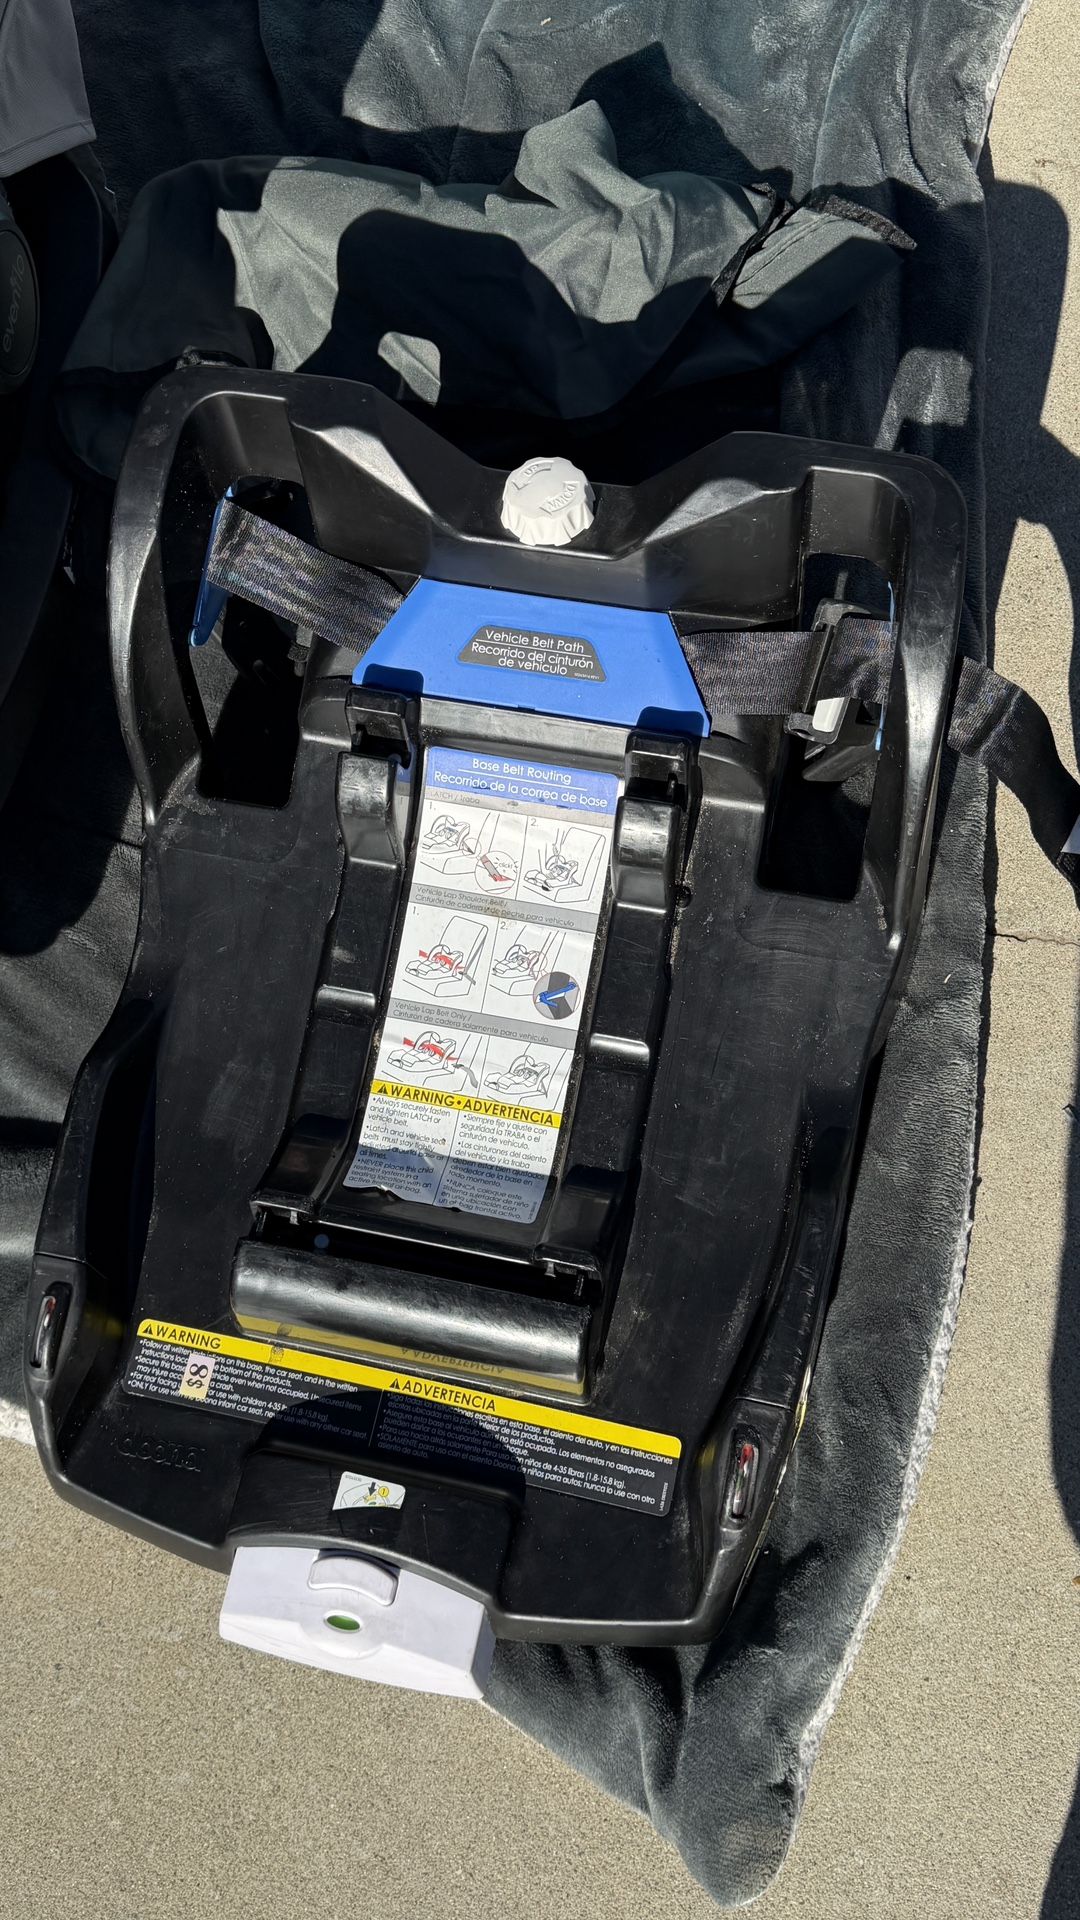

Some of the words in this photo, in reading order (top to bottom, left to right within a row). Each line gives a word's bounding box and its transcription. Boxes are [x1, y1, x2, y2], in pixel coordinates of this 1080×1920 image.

[486, 630, 529, 645] Vehicle
[533, 636, 554, 648] Belt
[557, 640, 584, 653] Path
[472, 642, 525, 658] Recorrido
[528, 650, 545, 662] del
[549, 654, 593, 669] cinturón
[498, 657, 514, 667] de
[471, 758, 500, 772] Base
[503, 763, 523, 776] Belt
[526, 767, 572, 785] Routing
[433, 770, 490, 790] Recorrido
[489, 780, 505, 792] de
[507, 782, 519, 794] la
[520, 786, 558, 800] correa
[560, 791, 576, 803] de
[579, 793, 608, 808] base
[416, 885, 442, 896] Vehicle
[443, 890, 457, 900] Lap
[445, 898, 455, 906] de
[526, 914, 543, 923] para
[394, 1001, 420, 1012] Vehicle
[421, 1006, 435, 1015] Lap
[436, 1008, 449, 1017] Belt
[450, 1011, 466, 1021] Only
[423, 1014, 433, 1022] de
[434, 1016, 461, 1027] cadera
[461, 1021, 499, 1034] solamente
[499, 1029, 517, 1038] para
[375, 1096, 400, 1108] Always
[400, 1101, 428, 1113] securely
[429, 1107, 450, 1116] fasten
[390, 1085, 455, 1106] WARNING
[367, 1113, 392, 1123] vehicle
[369, 1105, 383, 1113] and
[384, 1108, 409, 1118] tighten
[410, 1112, 432, 1122] LATCH
[462, 1098, 554, 1125] ADVERTENCIA
[466, 1113, 494, 1126] Siempre
[495, 1118, 505, 1128] fije
[511, 1122, 532, 1133] ajuste
[369, 1125, 388, 1133] Latch
[389, 1129, 404, 1137] and
[405, 1132, 430, 1142] vehicle
[381, 1136, 398, 1144] must
[399, 1139, 413, 1147] stay
[458, 1130, 487, 1141] cinturón
[487, 1135, 497, 1143] de
[460, 1121, 494, 1134] seguridad
[504, 1129, 525, 1139] TRABA
[361, 1158, 382, 1167] NEVER
[455, 1148, 466, 1156] del
[510, 1158, 530, 1168] traba
[461, 1141, 472, 1149] Los
[472, 1143, 508, 1155] cinturones
[509, 1150, 520, 1158] del
[521, 1152, 547, 1163] asiento
[504, 1175, 521, 1183] base
[155, 1325, 221, 1349] WARNING
[135, 1365, 150, 1374] may
[151, 1368, 168, 1378] injure
[215, 1381, 234, 1391] crash.
[140, 1348, 174, 1361] instructions
[219, 1364, 243, 1375] bottom
[243, 1369, 251, 1377] of
[251, 1371, 263, 1380] the
[262, 1374, 293, 1387] products.
[142, 1339, 162, 1349] Follow
[162, 1343, 171, 1351] all
[171, 1345, 192, 1356] written
[225, 1357, 235, 1365] on
[235, 1359, 246, 1367] this
[246, 1361, 264, 1372] base,
[264, 1365, 276, 1374] the
[275, 1369, 287, 1377] car
[287, 1370, 303, 1381] seat,
[303, 1374, 318, 1384] and
[317, 1377, 325, 1385] in
[324, 1379, 336, 1388] the
[336, 1381, 358, 1393] written
[186, 1363, 209, 1389] $8
[137, 1356, 159, 1366] Secure
[159, 1360, 171, 1369] this
[229, 1376, 246, 1385] even
[246, 1379, 265, 1389] when
[264, 1383, 277, 1392] not
[276, 1385, 310, 1401] occupied.
[143, 1374, 156, 1382] rear
[156, 1377, 177, 1388] facing
[227, 1393, 241, 1401] with
[241, 1394, 267, 1407] children
[267, 1400, 281, 1410] 4-35
[401, 1379, 497, 1411] ADVERTENCIA
[130, 1380, 148, 1389] ONLY
[217, 1399, 236, 1409] infant
[236, 1404, 248, 1412] car
[247, 1406, 264, 1416] seat,
[339, 1427, 352, 1436] car
[474, 1412, 498, 1423] escritas
[508, 1420, 523, 1429] esta
[523, 1423, 542, 1433] base,
[549, 1429, 574, 1441] asiento
[574, 1435, 586, 1444] del
[586, 1438, 604, 1448] auto,
[604, 1443, 609, 1451] y
[609, 1444, 619, 1452] en
[619, 1445, 630, 1454] las
[630, 1448, 673, 1464] instrucciones
[478, 1420, 500, 1432] inferior
[500, 1425, 510, 1434] de
[510, 1427, 520, 1436] los
[520, 1430, 556, 1445] productos.
[499, 1435, 509, 1443] no
[509, 1436, 524, 1447] está
[523, 1440, 558, 1455] ocupada.
[558, 1448, 569, 1457] Los
[570, 1451, 605, 1465] elementos
[606, 1460, 615, 1468] no
[614, 1461, 655, 1478] asegurados
[524, 1457, 542, 1468] niños
[542, 1461, 552, 1470] de
[552, 1464, 567, 1473] 4-35
[567, 1467, 585, 1478] libras
[527, 1467, 544, 1478] niños
[544, 1472, 561, 1483] para
[583, 1481, 605, 1492] nunca
[605, 1486, 613, 1494] lo
[613, 1489, 625, 1497] use
[625, 1492, 640, 1501] con
[640, 1494, 656, 1504] otro
